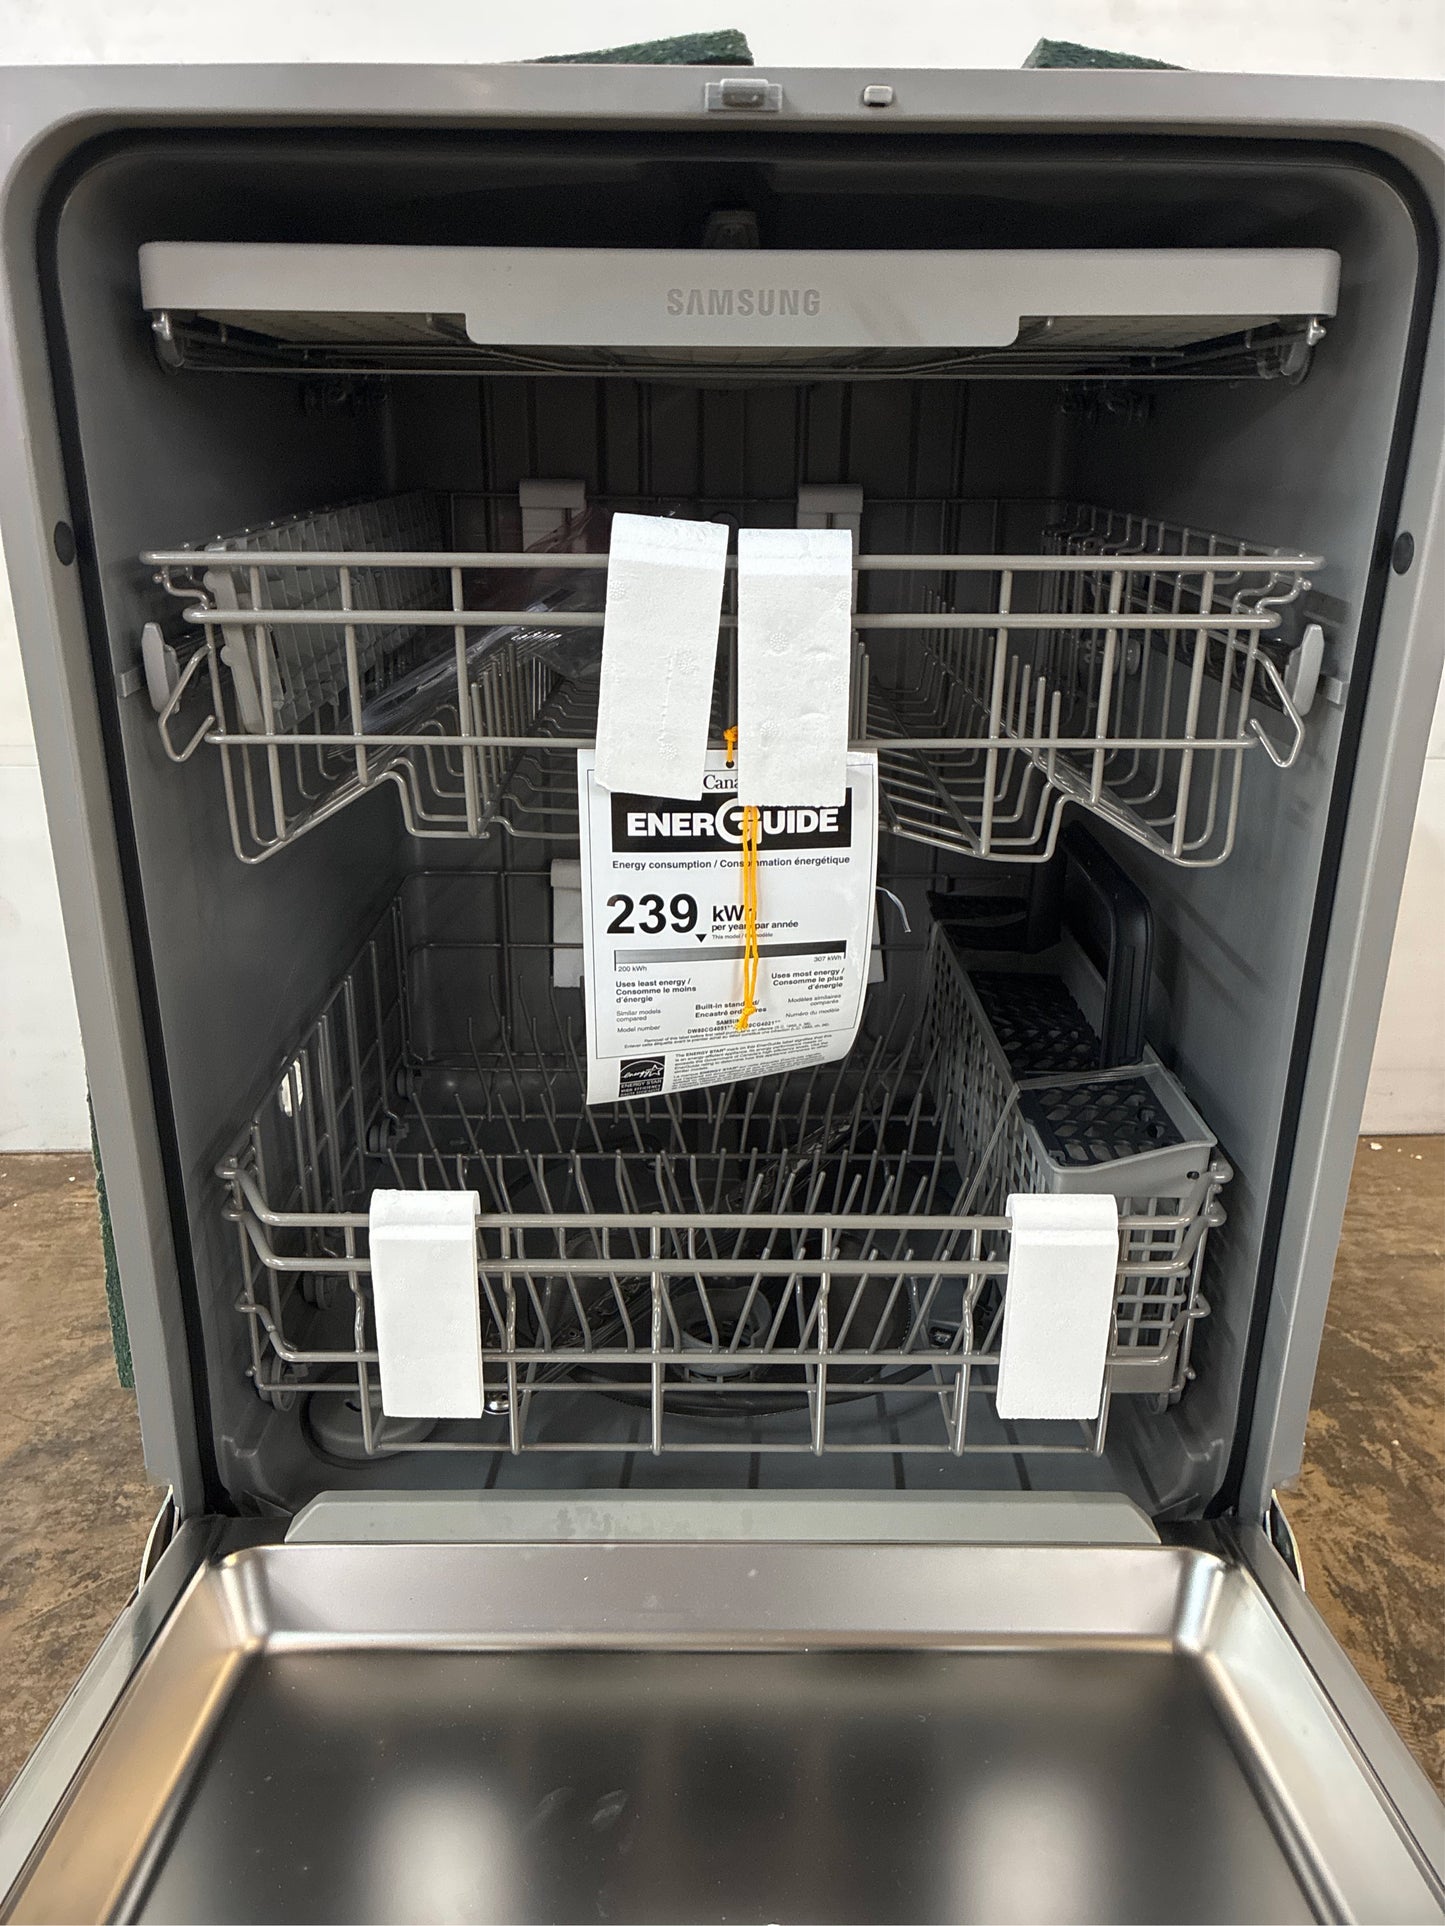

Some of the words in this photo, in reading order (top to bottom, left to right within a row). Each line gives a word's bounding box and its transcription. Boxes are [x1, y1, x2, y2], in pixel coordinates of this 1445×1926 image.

[667, 288, 821, 317] SAMSUNG
[613, 860, 646, 871] Energy
[648, 860, 712, 870] consumption
[713, 859, 718, 868] /
[794, 855, 850, 866] énergétique
[606, 893, 698, 935] 239
[713, 904, 757, 922] kW
[712, 924, 726, 933] per
[755, 921, 770, 932] par
[771, 920, 799, 929] année
[792, 970, 812, 978] most
[813, 969, 840, 977] energy
[615, 980, 636, 988] Uses
[773, 977, 817, 986] Consomme
[827, 974, 844, 984] plus
[807, 982, 843, 990] d'énergie
[615, 987, 661, 996] Consomme
[615, 995, 653, 1004] d'énergie
[695, 1003, 723, 1011] Built-in
[639, 1008, 661, 1016] models
[695, 1009, 728, 1018] Encastré
[616, 1015, 648, 1023] compared
